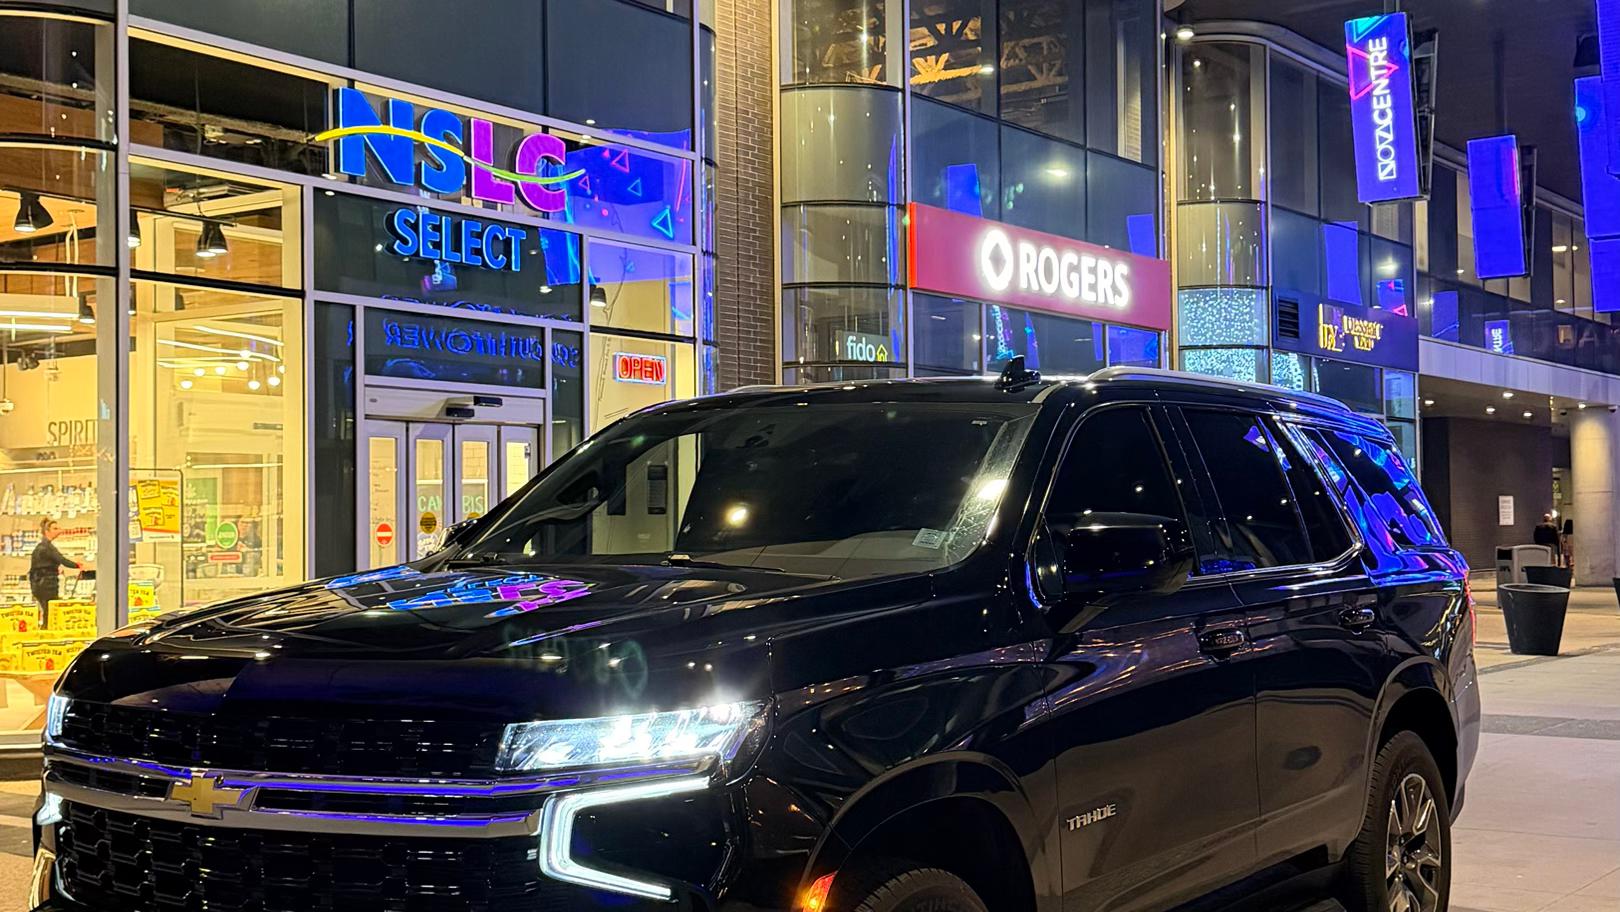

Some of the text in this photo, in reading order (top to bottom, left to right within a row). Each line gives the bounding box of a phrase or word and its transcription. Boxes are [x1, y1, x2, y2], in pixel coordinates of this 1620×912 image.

[338, 87, 566, 213] NSLC
[392, 208, 527, 272] SELECT
[1018, 241, 1130, 308] ROGERS
[619, 355, 665, 382] OPEN
[846, 335, 876, 362] fido
[1066, 803, 1117, 831] TAHOE
